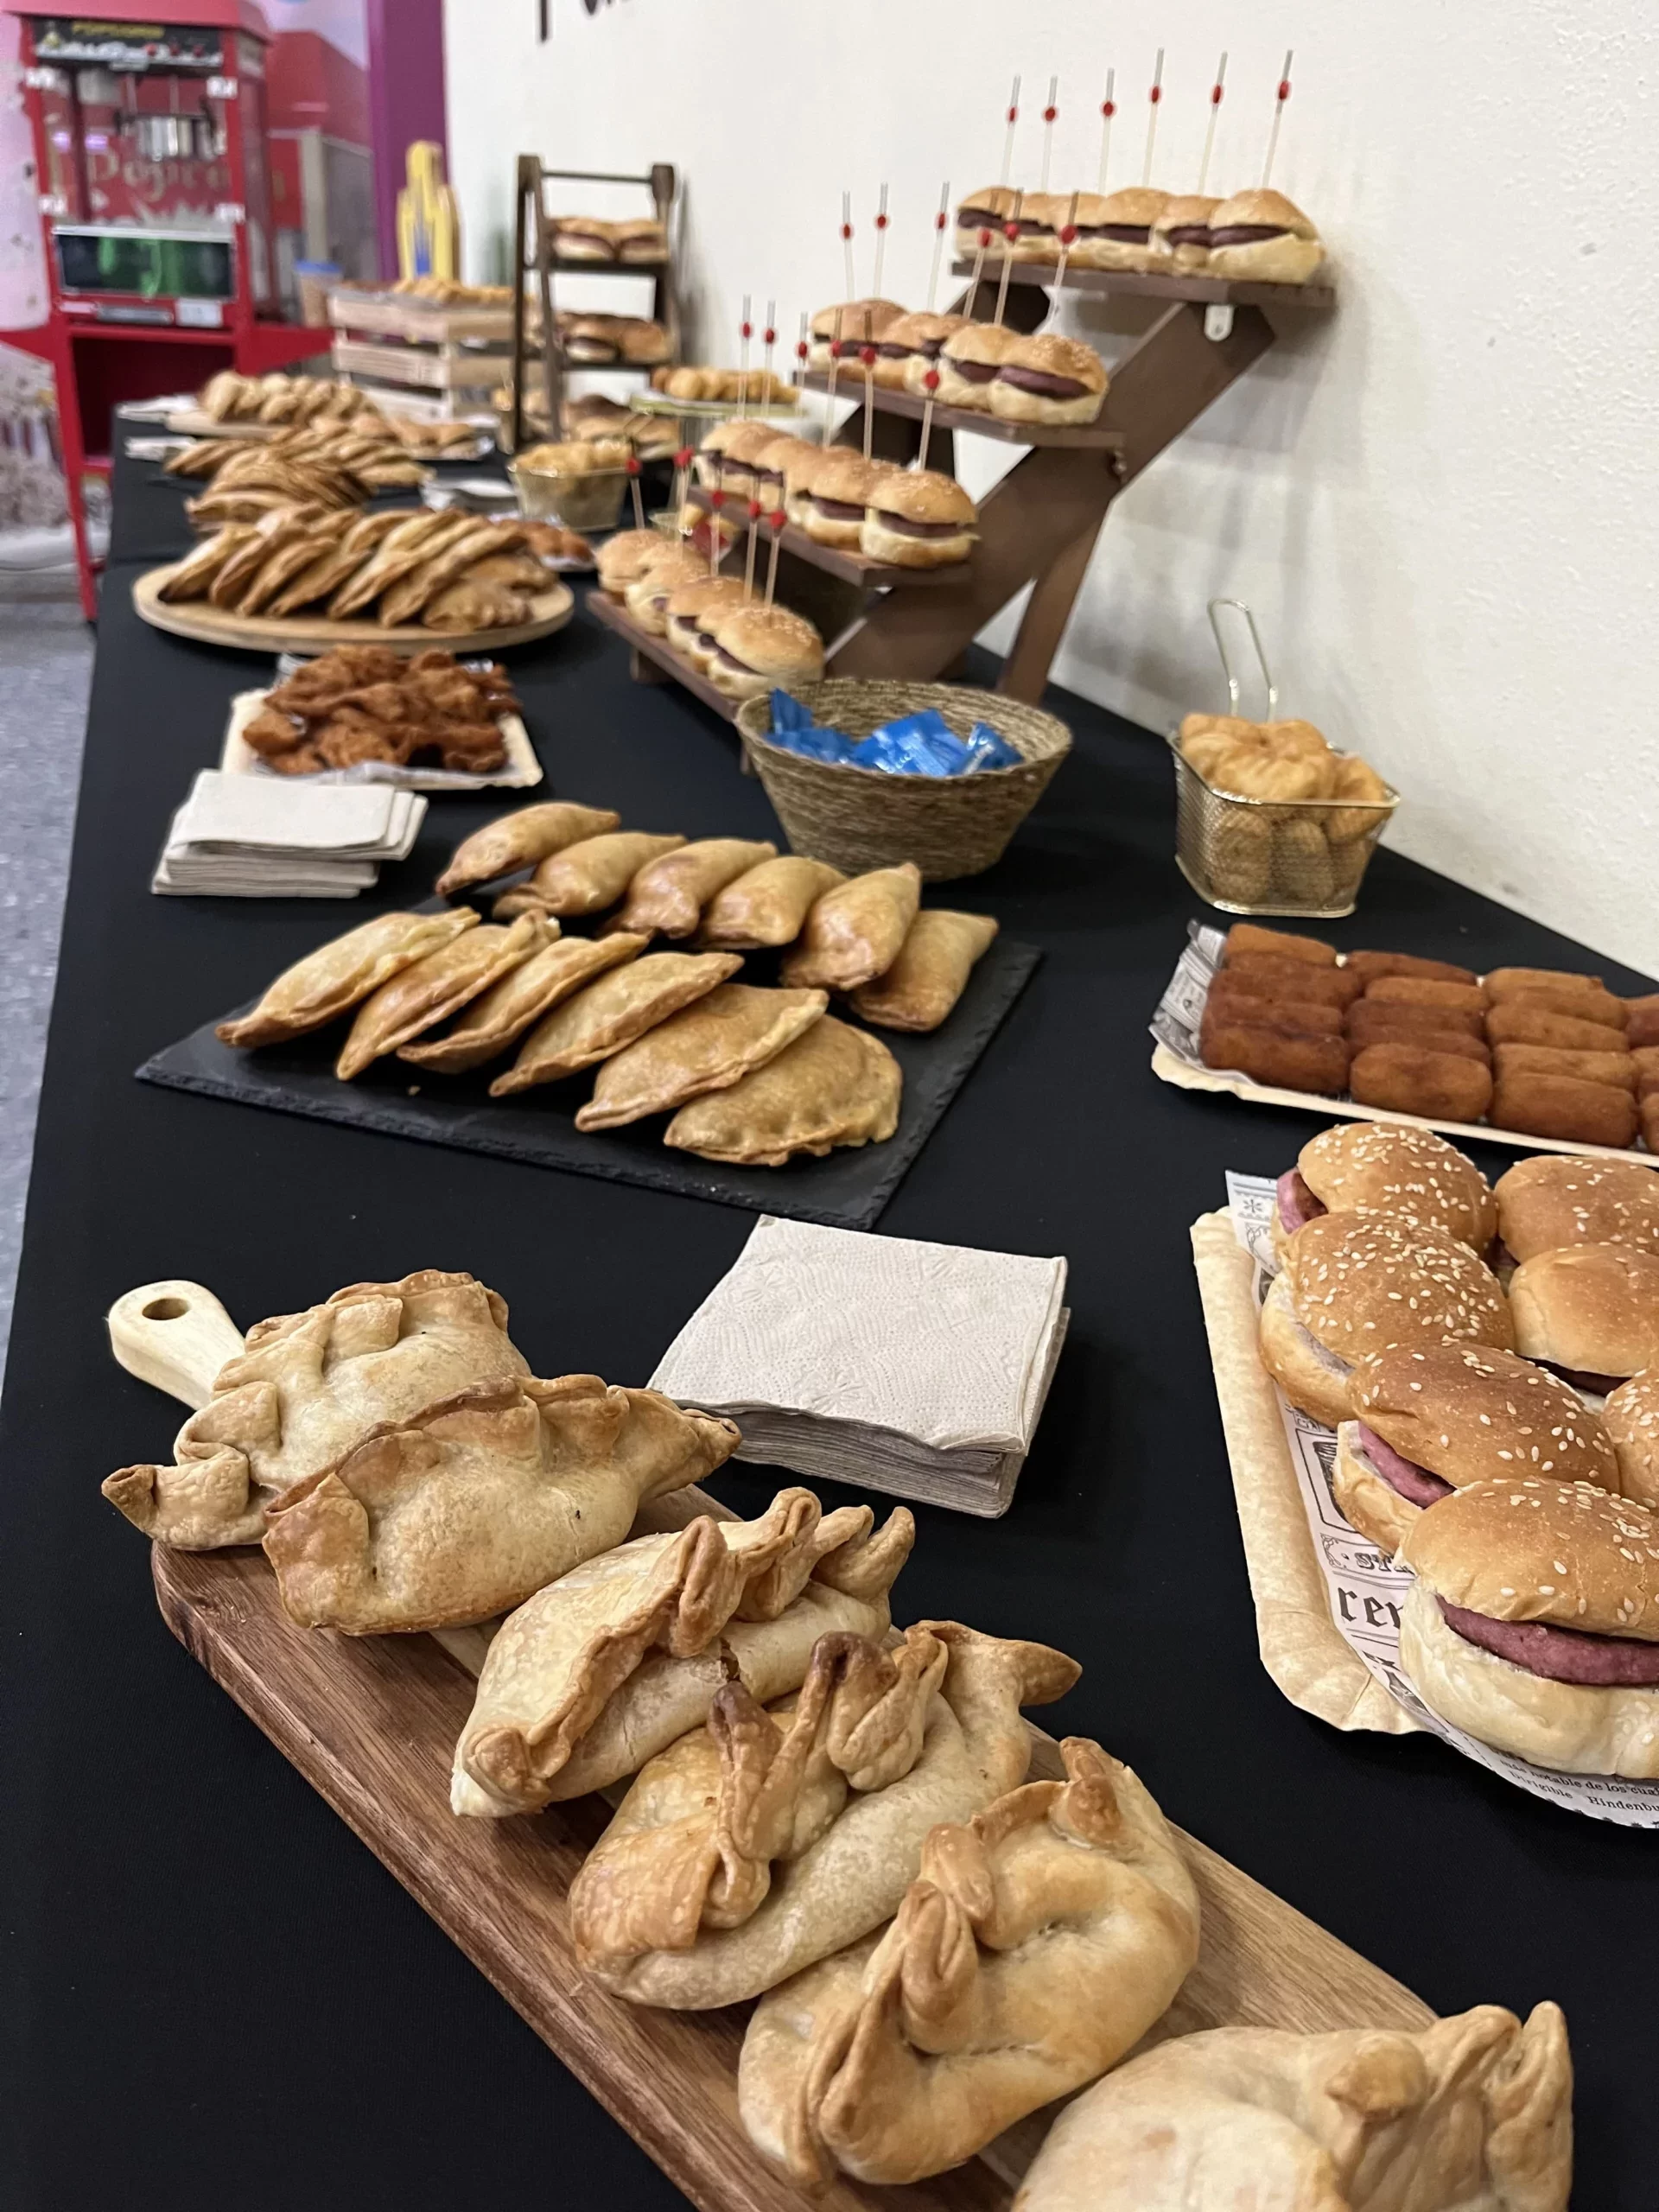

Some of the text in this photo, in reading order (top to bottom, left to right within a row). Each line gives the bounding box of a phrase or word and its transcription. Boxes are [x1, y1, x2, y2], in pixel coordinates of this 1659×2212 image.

[1530, 1770, 1582, 1788] notable
[1586, 1780, 1603, 1790] de
[1605, 1782, 1627, 1793] los
